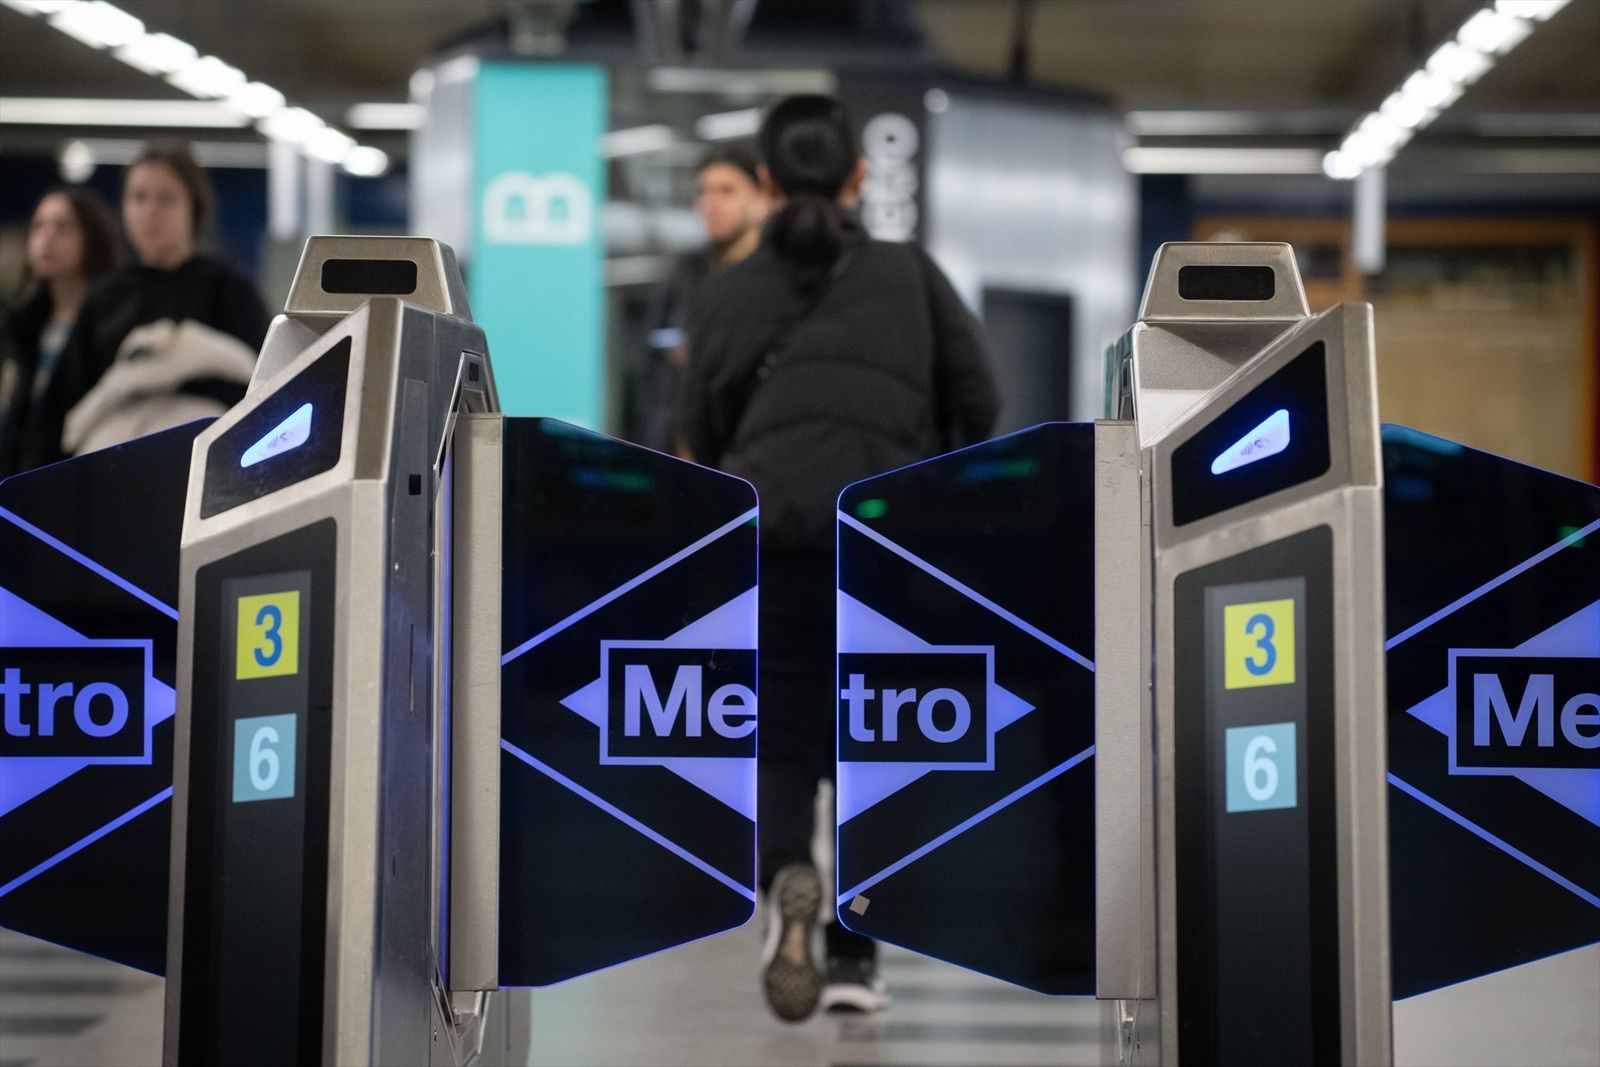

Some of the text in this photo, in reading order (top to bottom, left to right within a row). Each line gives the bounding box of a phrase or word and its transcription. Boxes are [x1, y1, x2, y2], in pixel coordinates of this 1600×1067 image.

[253, 604, 283, 667] 3
[1243, 613, 1278, 677] 3
[249, 725, 279, 792] 6
[1243, 735, 1279, 801] 6
